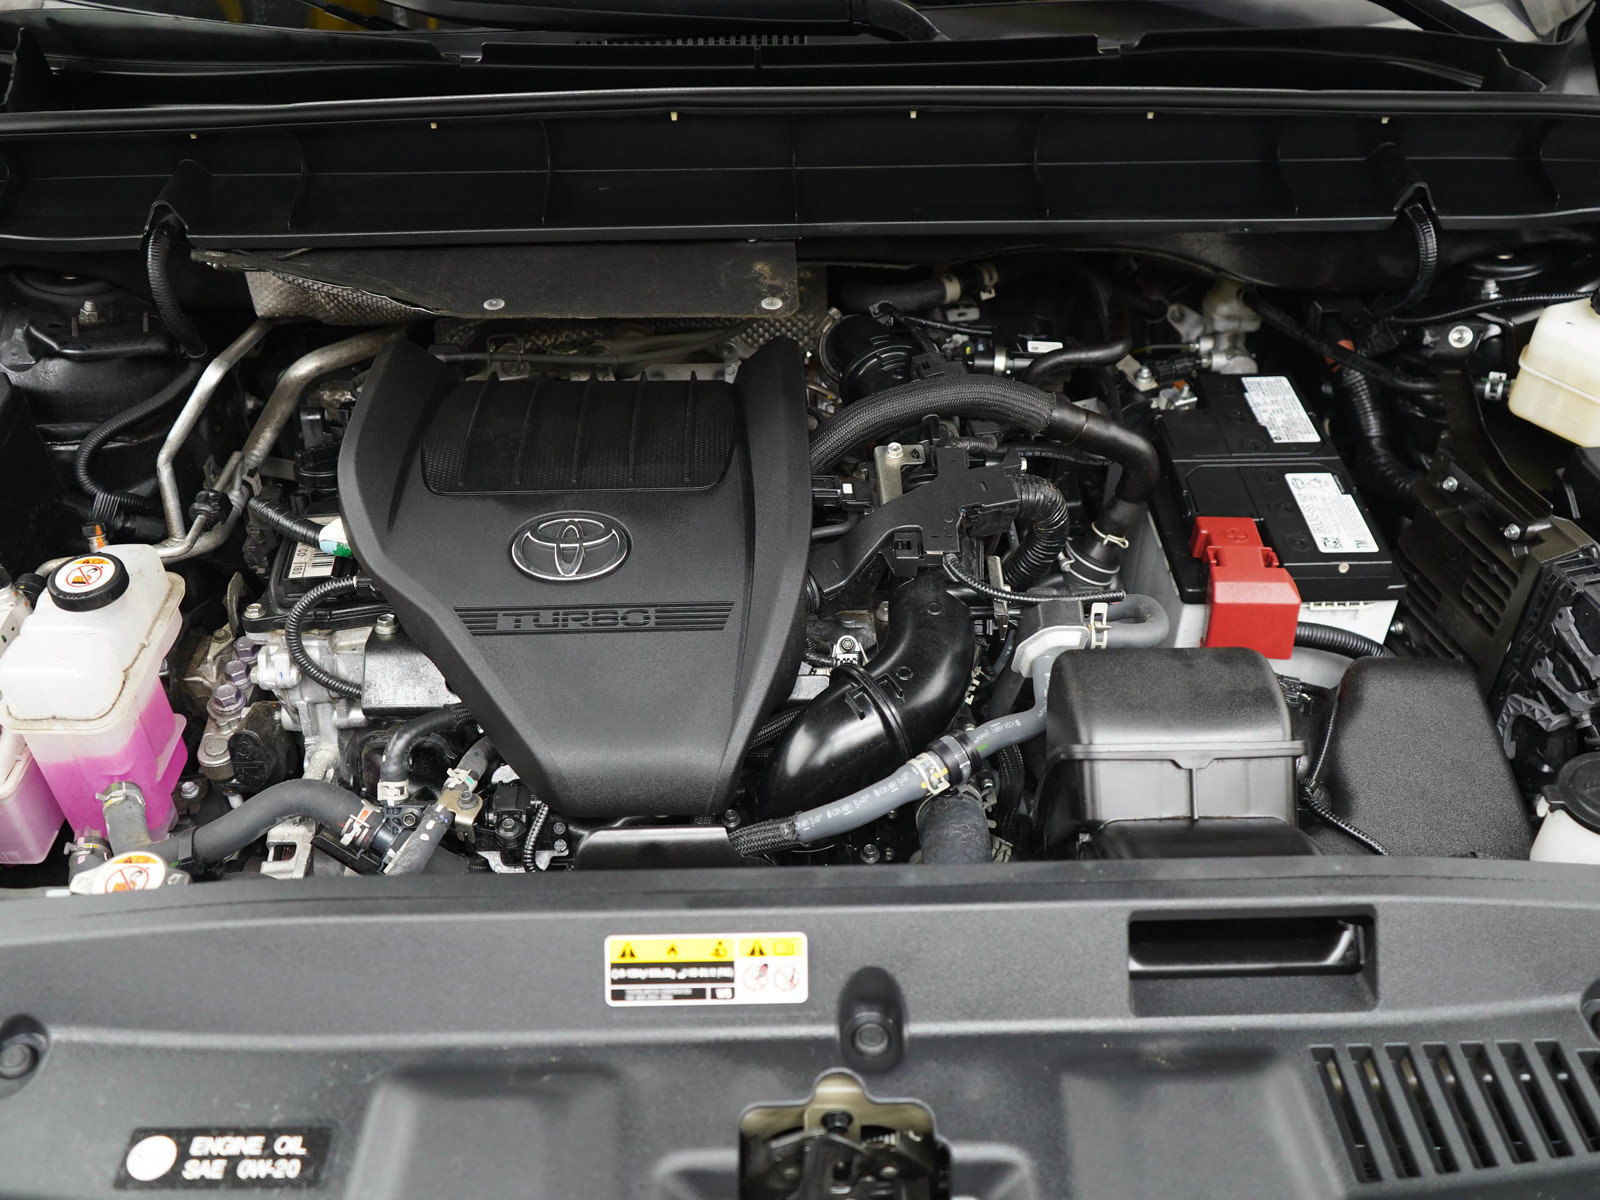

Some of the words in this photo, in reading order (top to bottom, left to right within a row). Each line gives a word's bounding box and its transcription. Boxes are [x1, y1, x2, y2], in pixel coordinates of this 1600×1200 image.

[502, 608, 651, 629] TURBO
[188, 1135, 266, 1157] ENGINE
[273, 1135, 307, 1156] OIL
[181, 1158, 228, 1180] SAE
[236, 1158, 302, 1180] 0W-20
